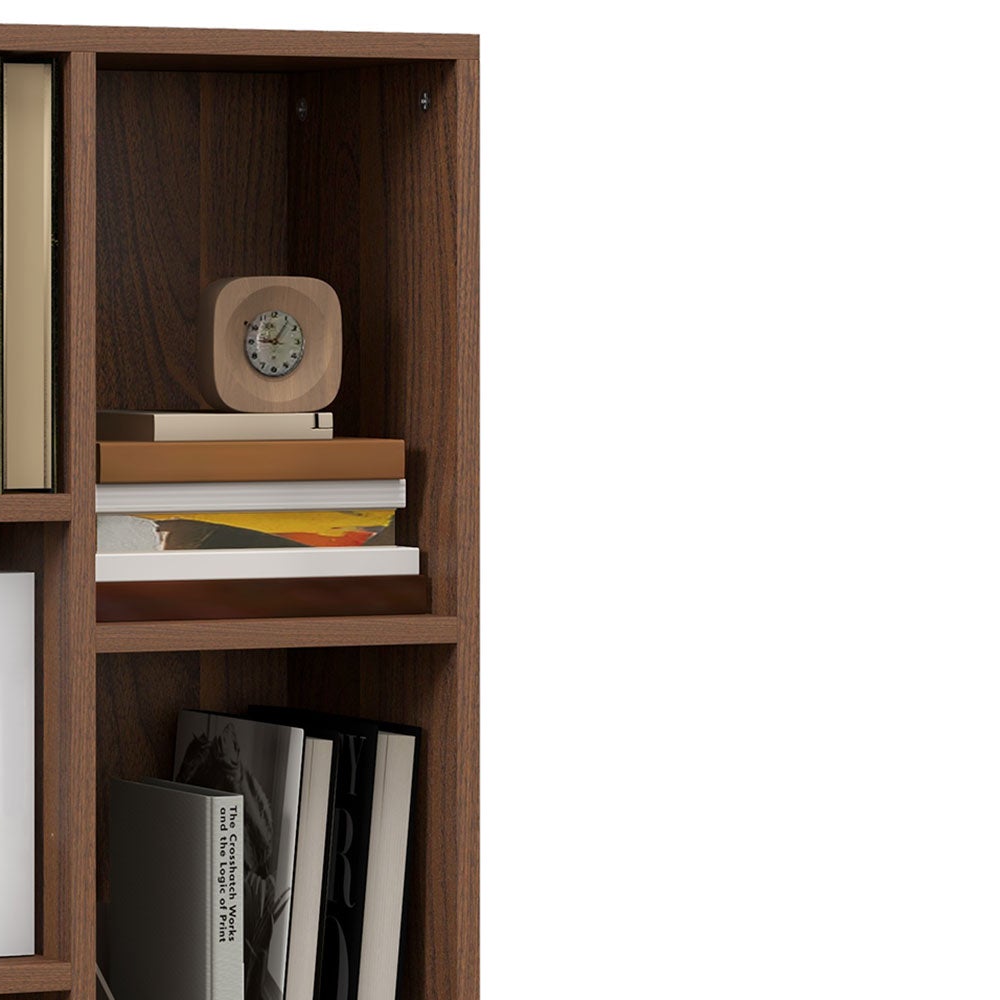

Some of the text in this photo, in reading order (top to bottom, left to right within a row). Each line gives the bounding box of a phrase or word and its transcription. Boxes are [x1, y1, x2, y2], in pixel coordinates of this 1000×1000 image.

[217, 806, 228, 943] and the Logic of Print
[228, 805, 238, 942] The Crosshatch Works
